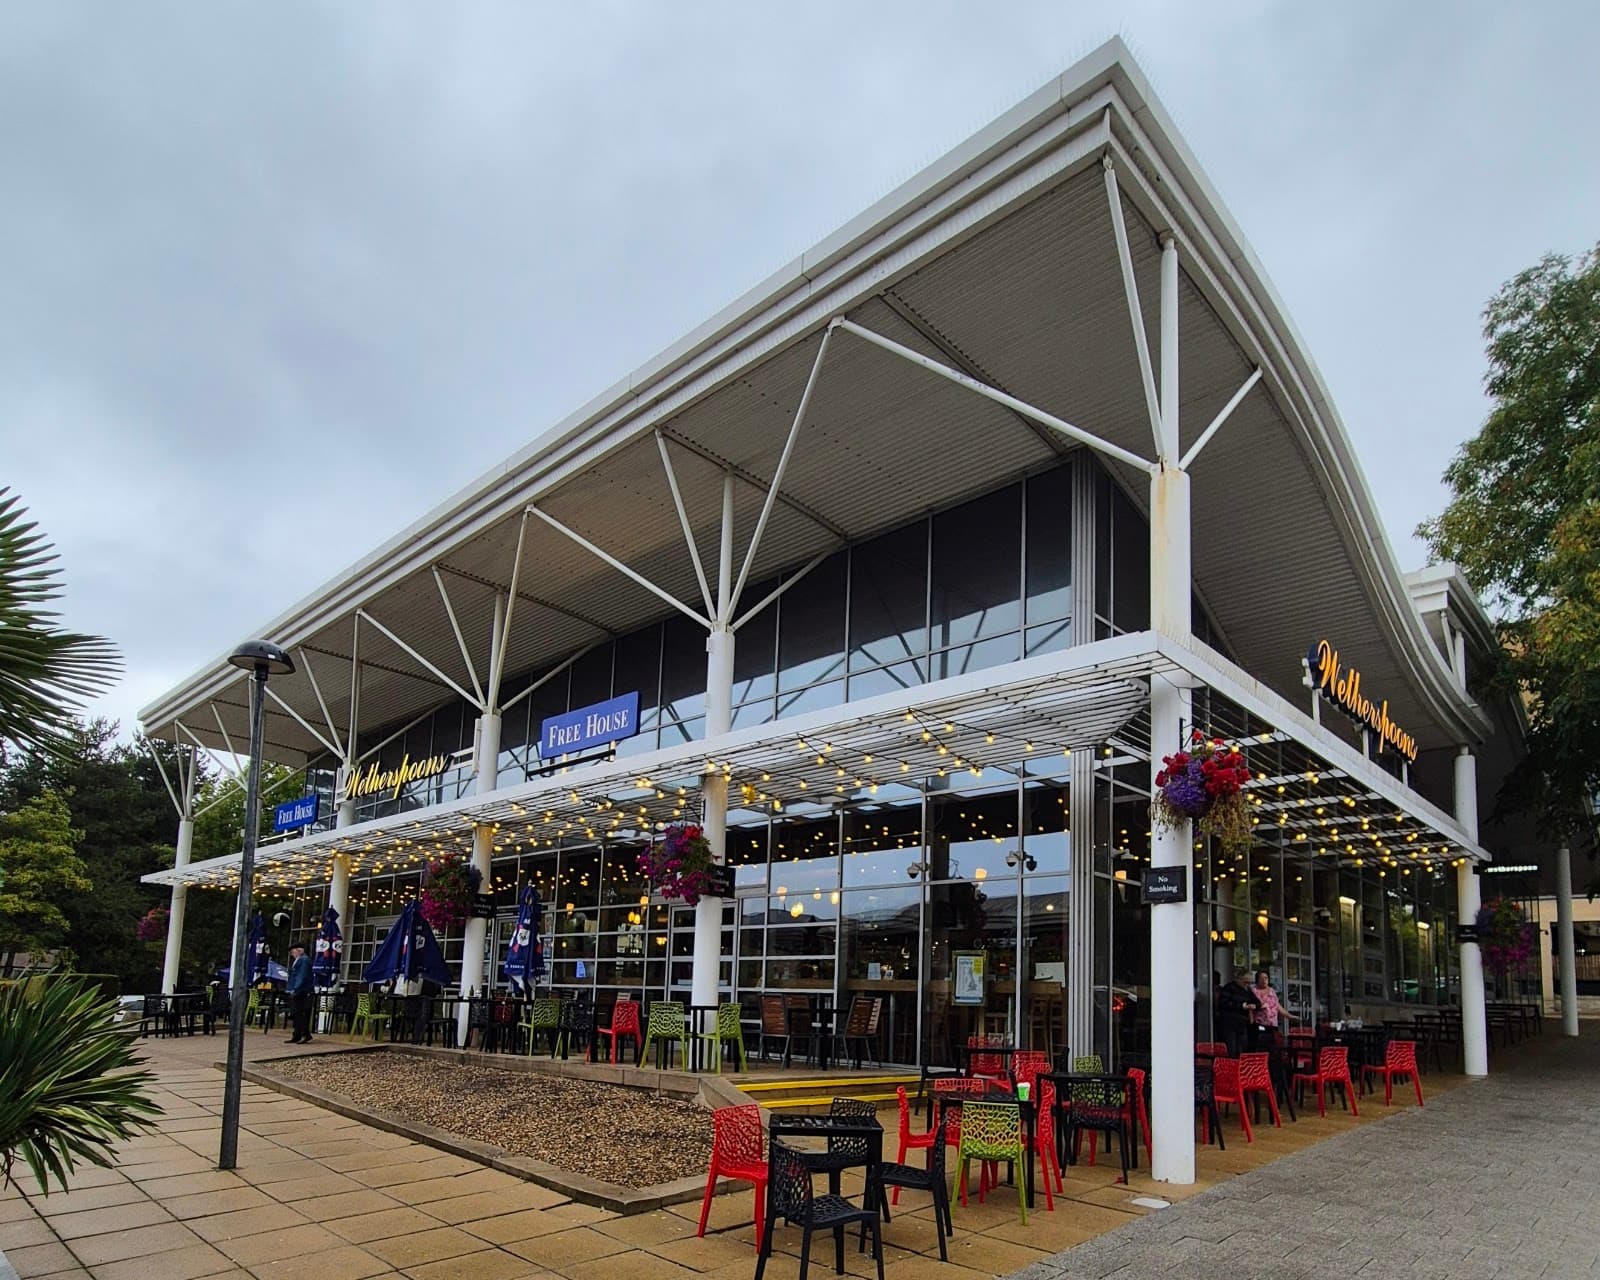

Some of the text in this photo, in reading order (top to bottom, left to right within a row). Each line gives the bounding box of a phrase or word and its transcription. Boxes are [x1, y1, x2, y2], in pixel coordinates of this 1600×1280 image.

[1318, 640, 1418, 761] Wetherspoons
[549, 710, 629, 748] FREE HOUSE
[345, 753, 448, 800] Wetherspoons
[278, 804, 314, 825] FREE HOUSE
[1148, 884, 1178, 893] Smoking
